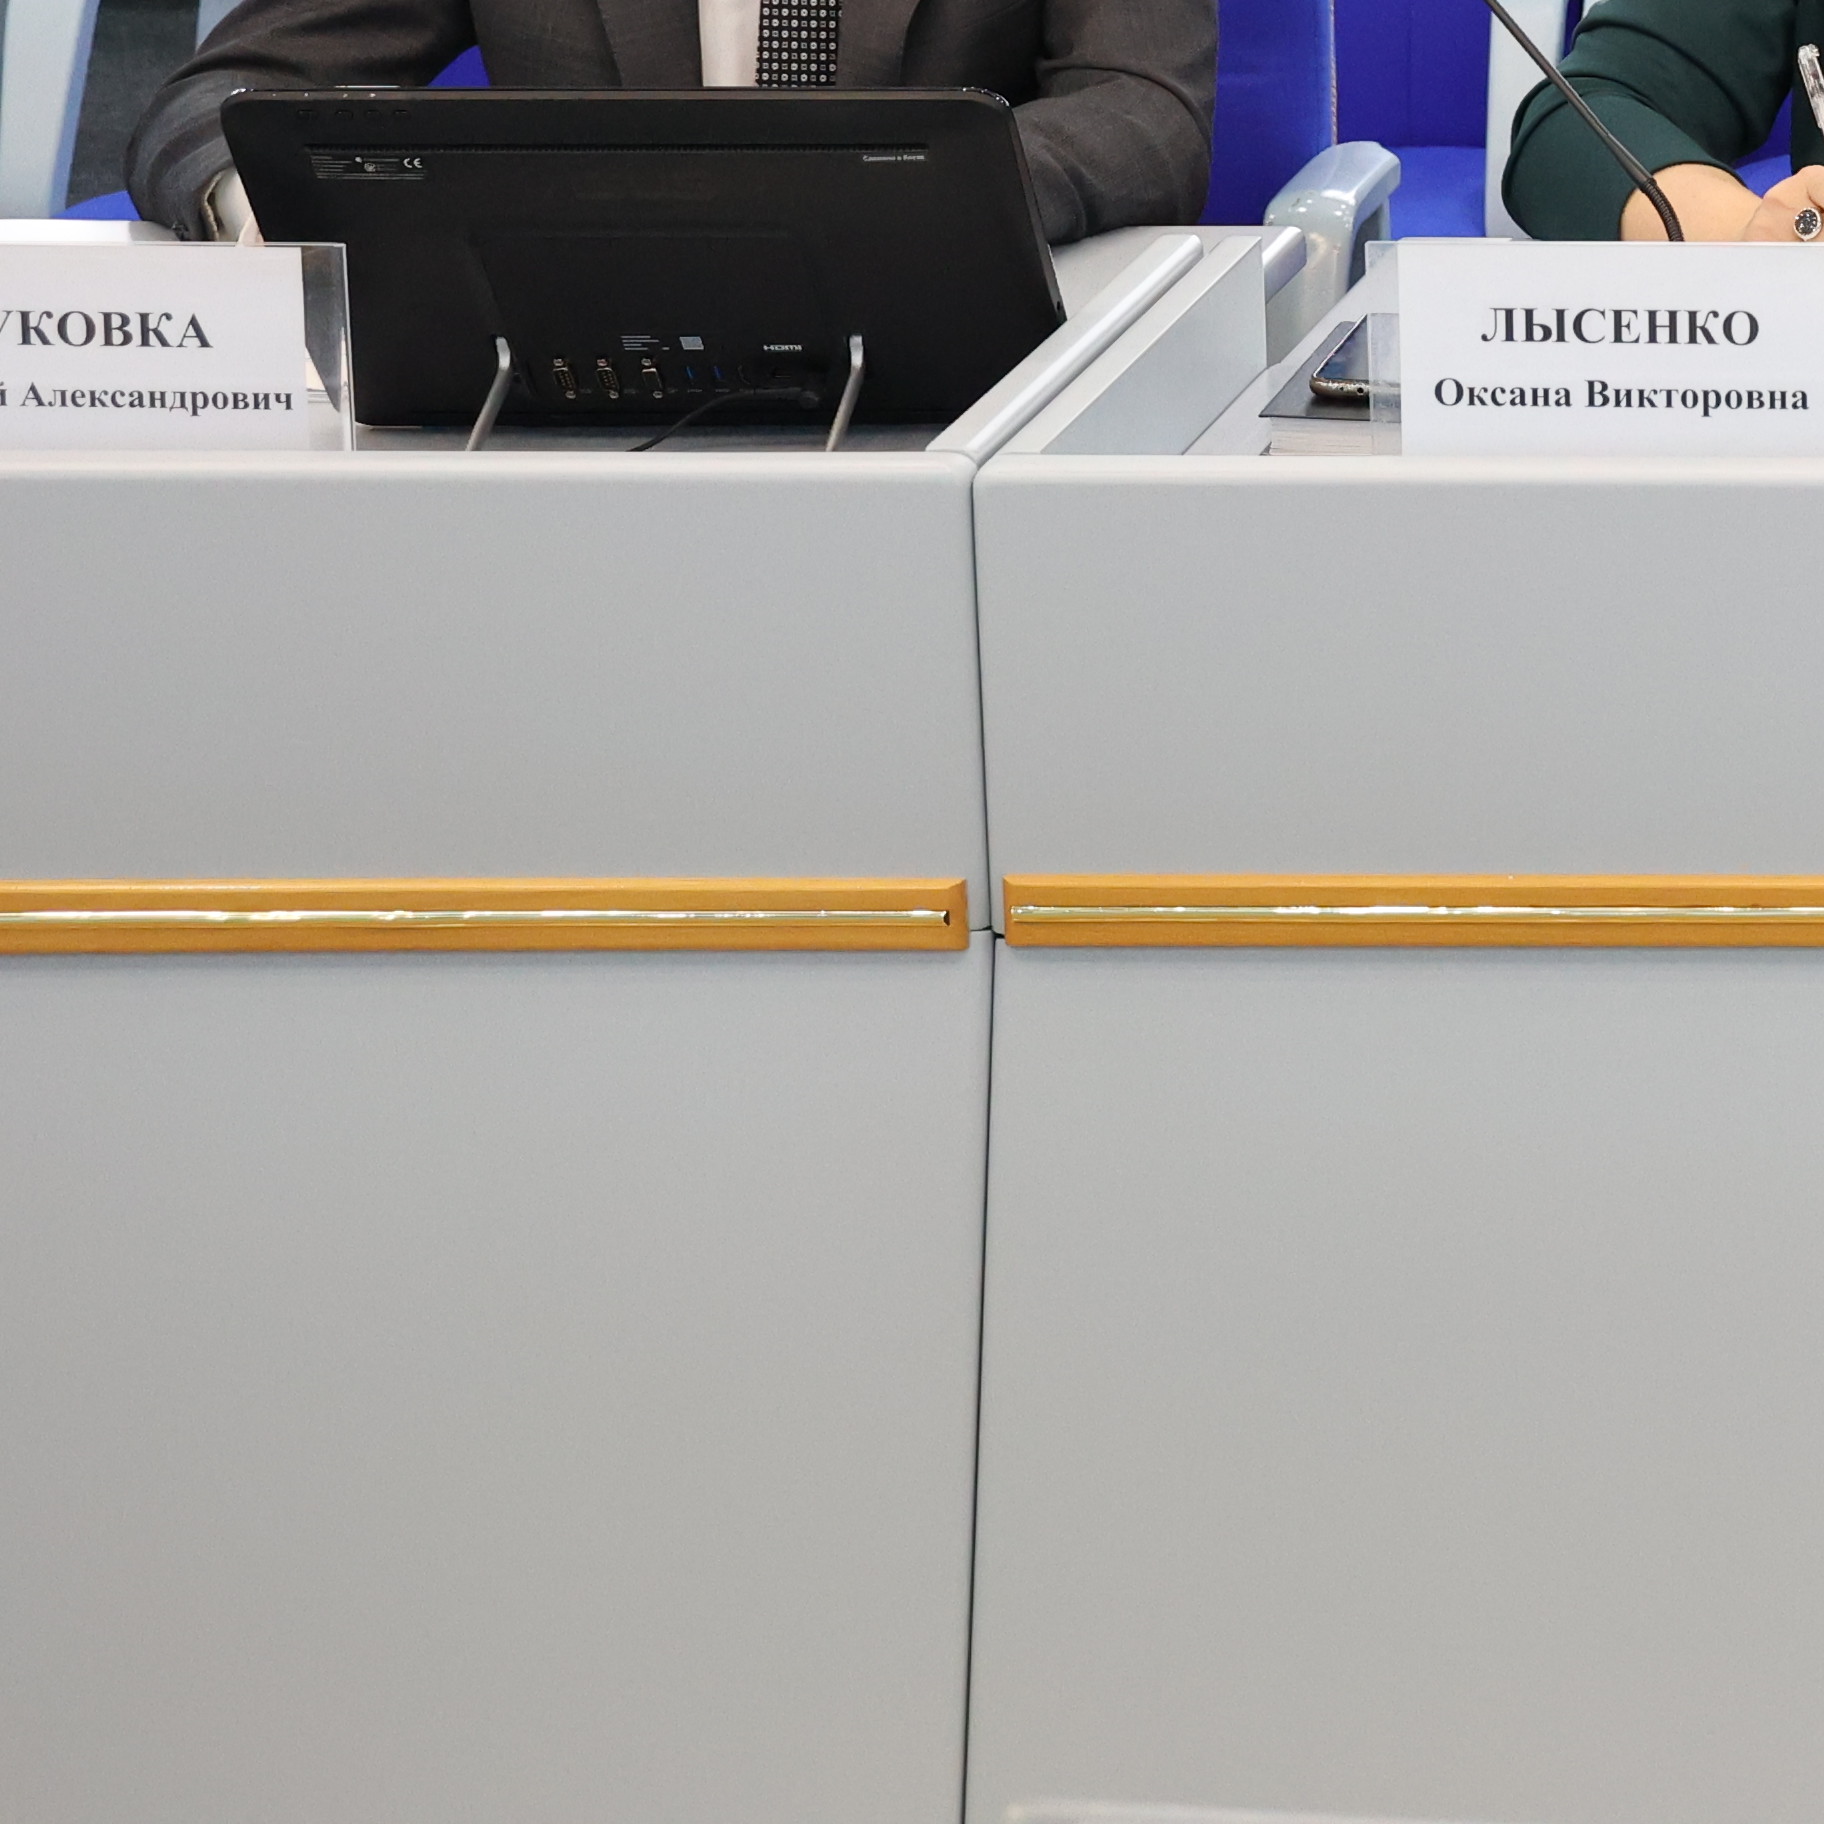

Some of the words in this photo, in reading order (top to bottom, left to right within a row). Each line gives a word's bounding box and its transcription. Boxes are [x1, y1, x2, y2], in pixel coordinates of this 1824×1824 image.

[1481, 308, 1759, 345] ЛЫСЕНКО
[20, 382, 293, 416] Александрович
[1435, 378, 1572, 407] Оксана
[1587, 380, 1808, 417] Викторовна
